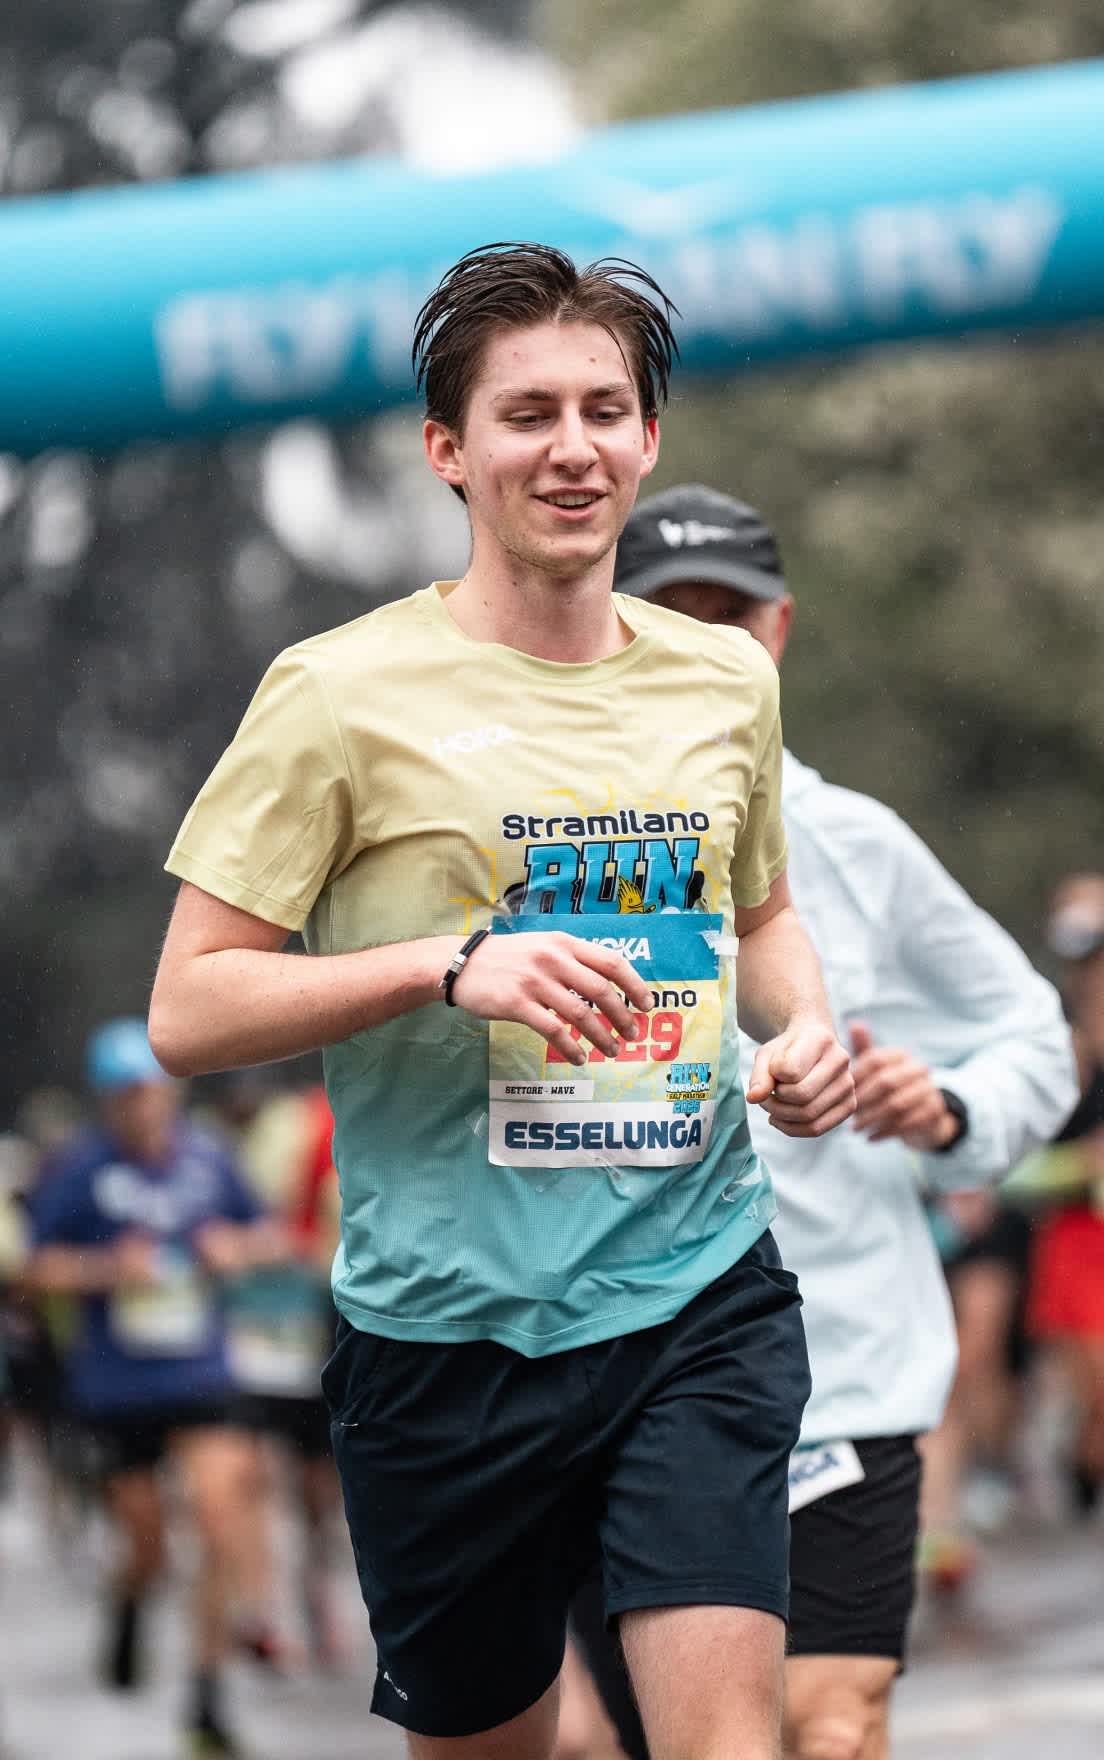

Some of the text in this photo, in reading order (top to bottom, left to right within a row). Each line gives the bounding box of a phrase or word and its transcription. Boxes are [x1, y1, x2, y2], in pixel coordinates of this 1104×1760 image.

[502, 809, 710, 840] Stramilano
[520, 838, 700, 914] RUN
[580, 937, 651, 961] OKA
[505, 1086, 543, 1095] SETTORE
[551, 1086, 575, 1095] WAVE
[504, 1119, 701, 1151] ESSELUNGA
